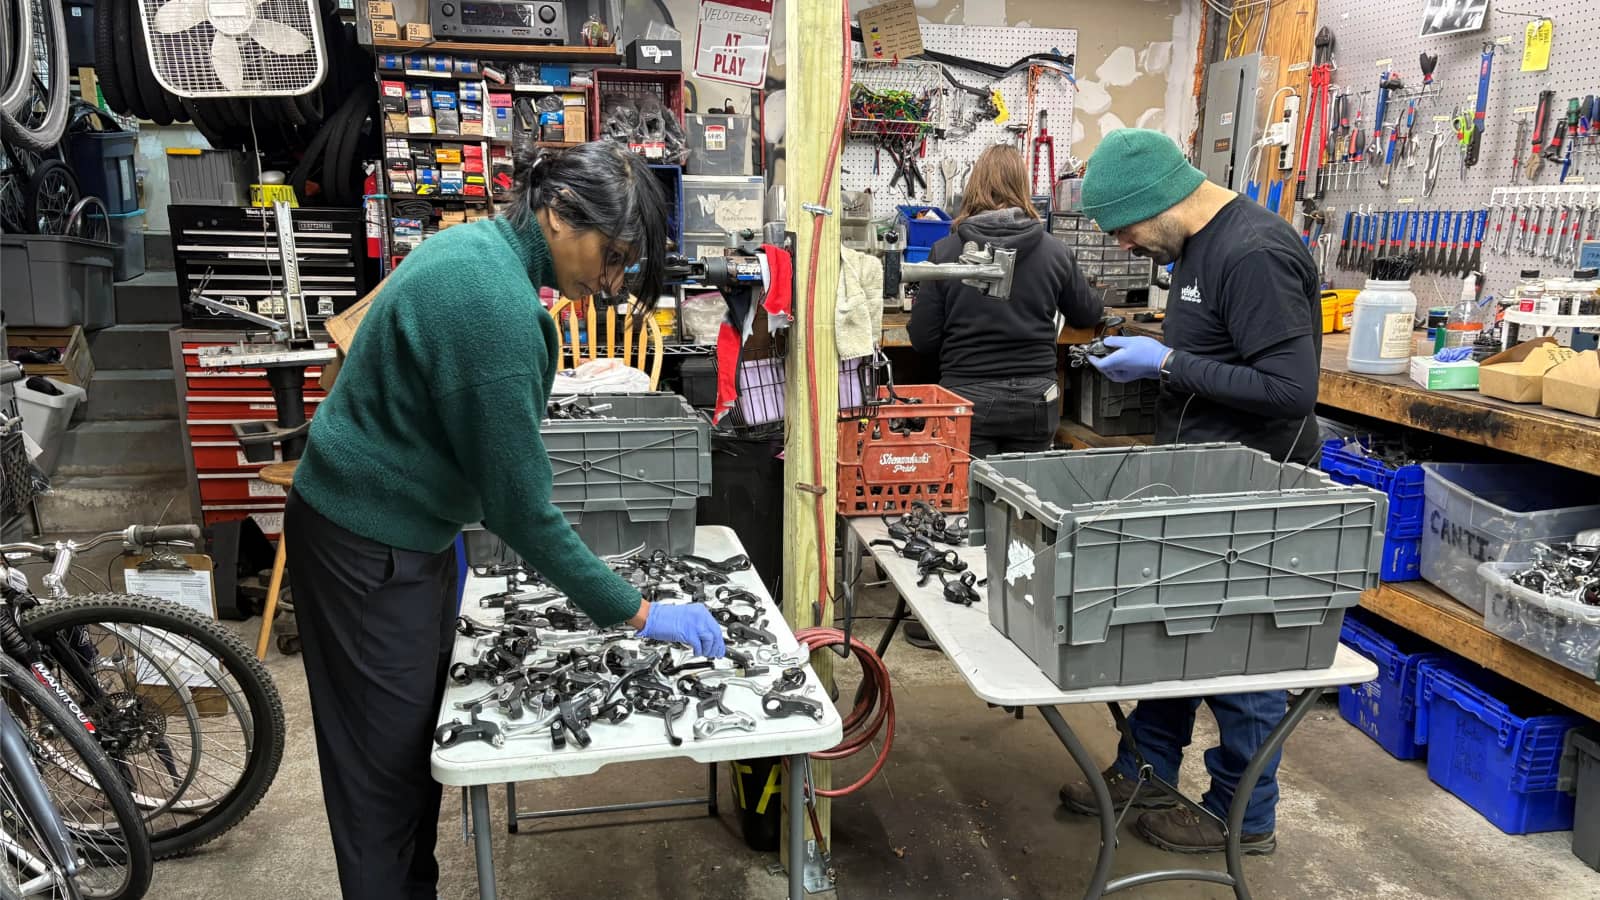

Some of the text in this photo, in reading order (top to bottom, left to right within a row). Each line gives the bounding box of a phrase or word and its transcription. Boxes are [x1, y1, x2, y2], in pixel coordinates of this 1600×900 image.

[704, 8, 763, 26] VELOTEERS
[723, 33, 741, 53] AT
[713, 53, 746, 77] PLAY
[892, 464, 917, 473] Pride
[34, 662, 89, 723] MANITOU
